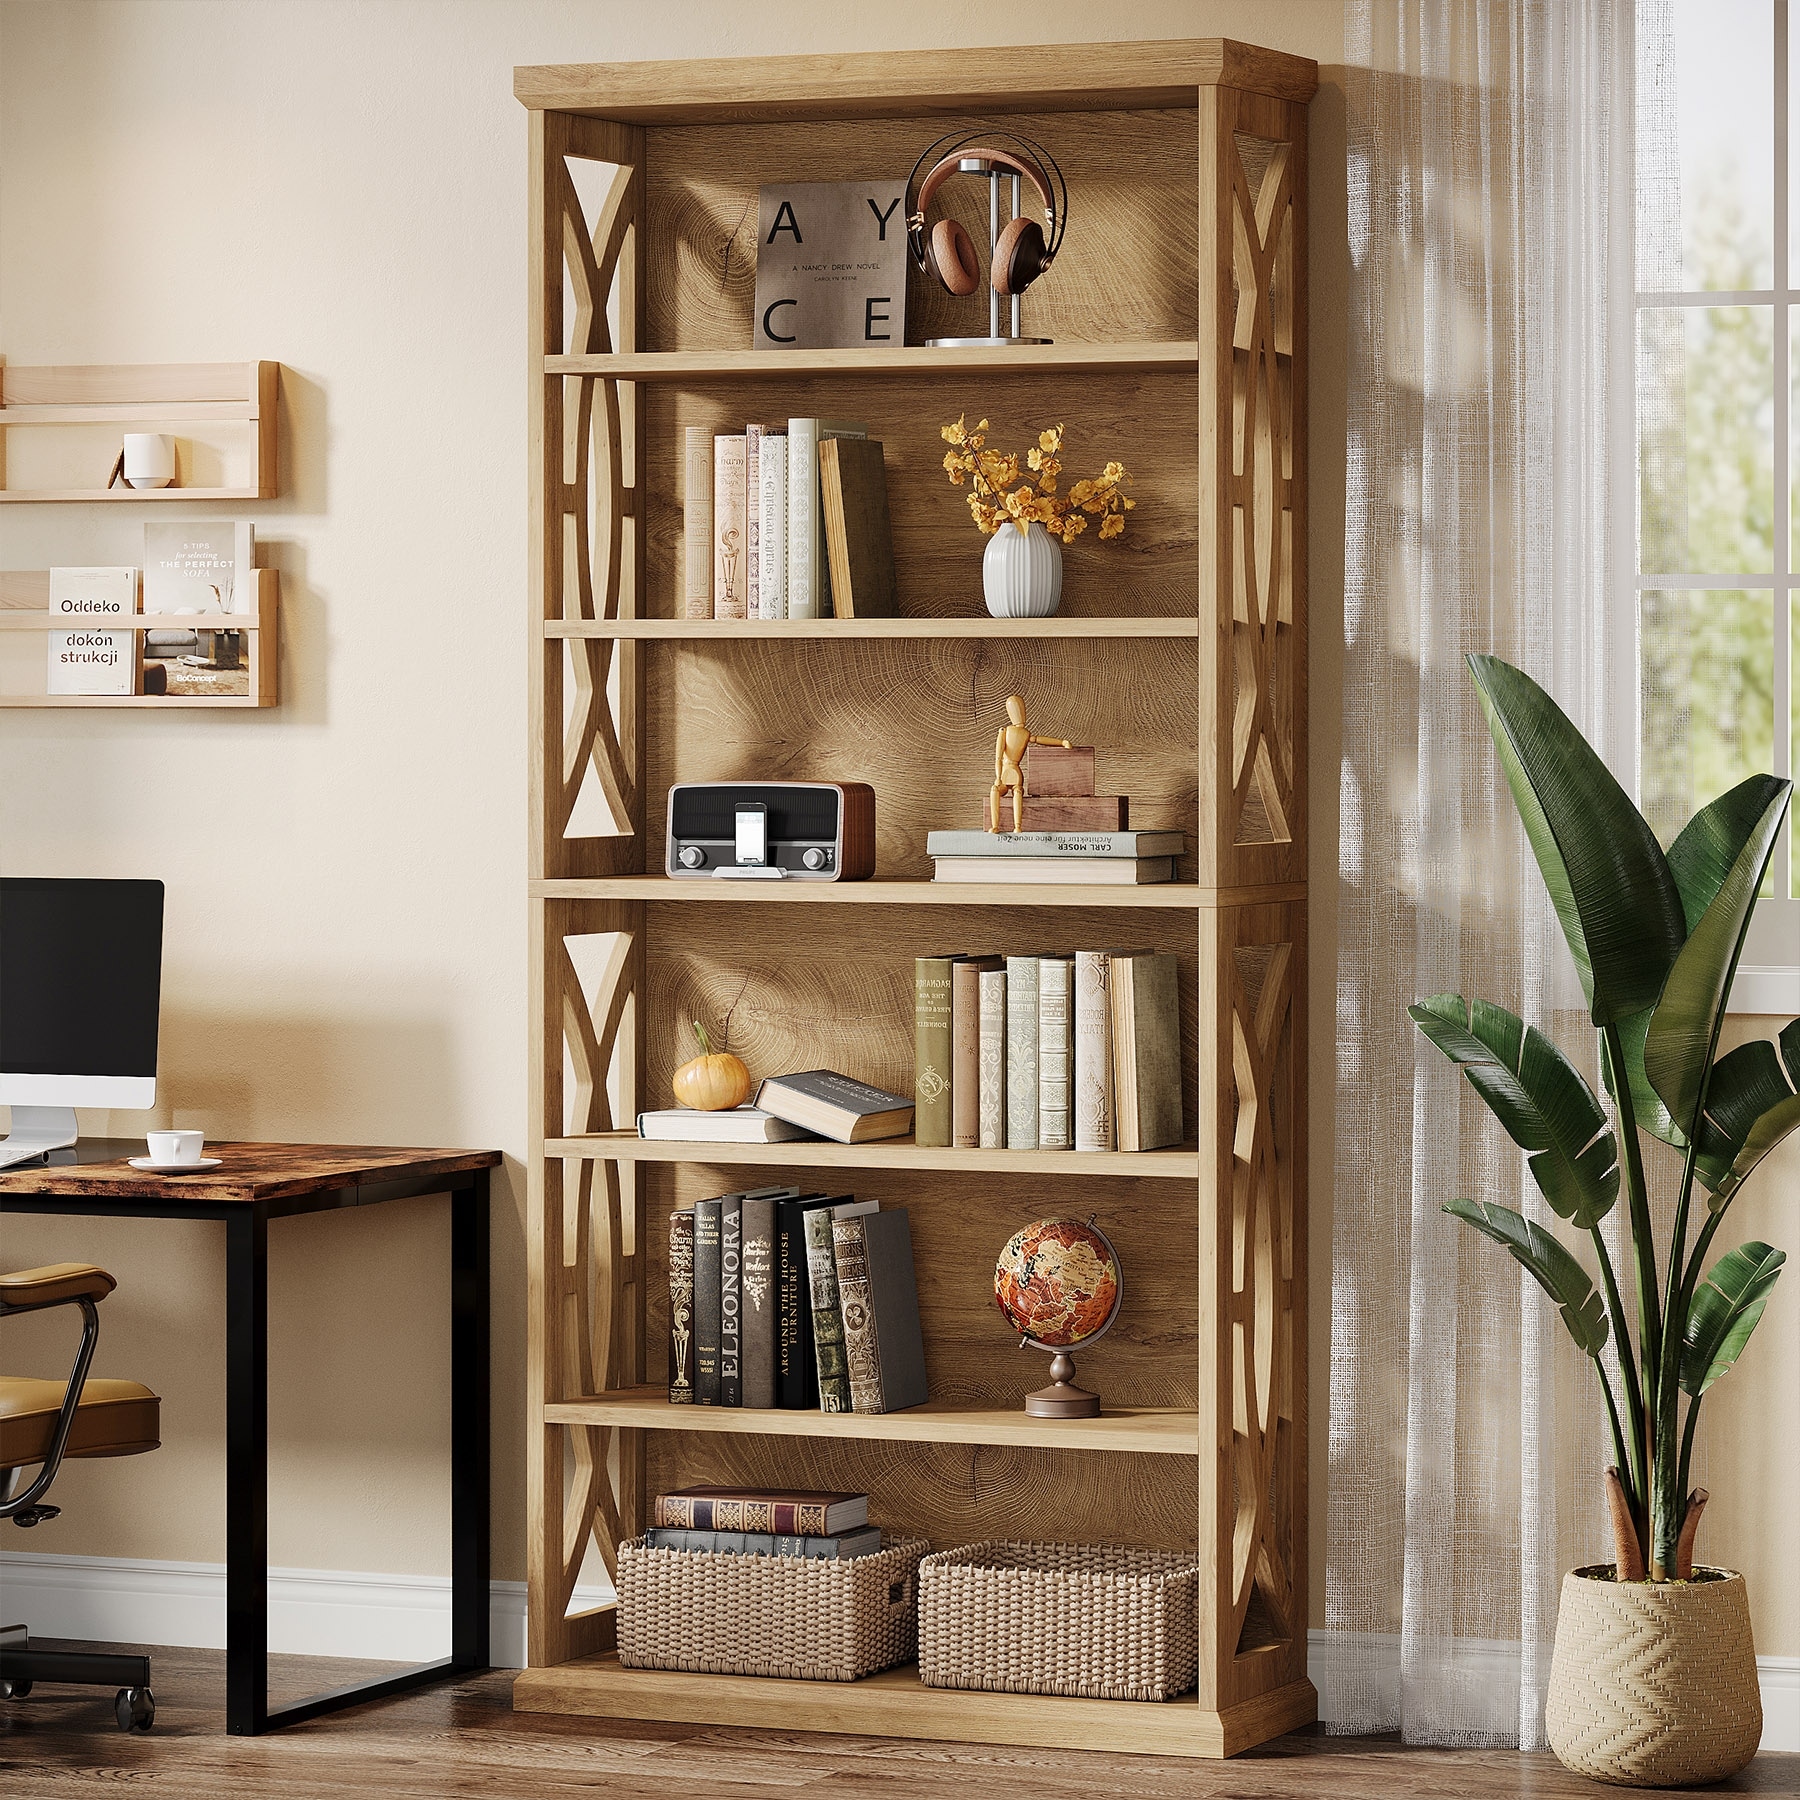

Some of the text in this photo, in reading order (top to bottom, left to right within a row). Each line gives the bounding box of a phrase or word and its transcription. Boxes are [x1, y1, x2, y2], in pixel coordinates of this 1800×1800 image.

[766, 198, 902, 244] A Y
[763, 298, 891, 343] C E
[175, 552, 218, 560] for selecting
[182, 570, 210, 578] SOFA
[60, 600, 120, 612] Oddeko
[60, 650, 118, 666] strukcji
[176, 674, 216, 684] BoConcept
[1067, 836, 1112, 844] Architektur
[722, 1210, 740, 1379] ELEONORA
[780, 1283, 788, 1312] THE
[790, 1264, 798, 1344] FURNITURE
[780, 1317, 788, 1376] AROUND
